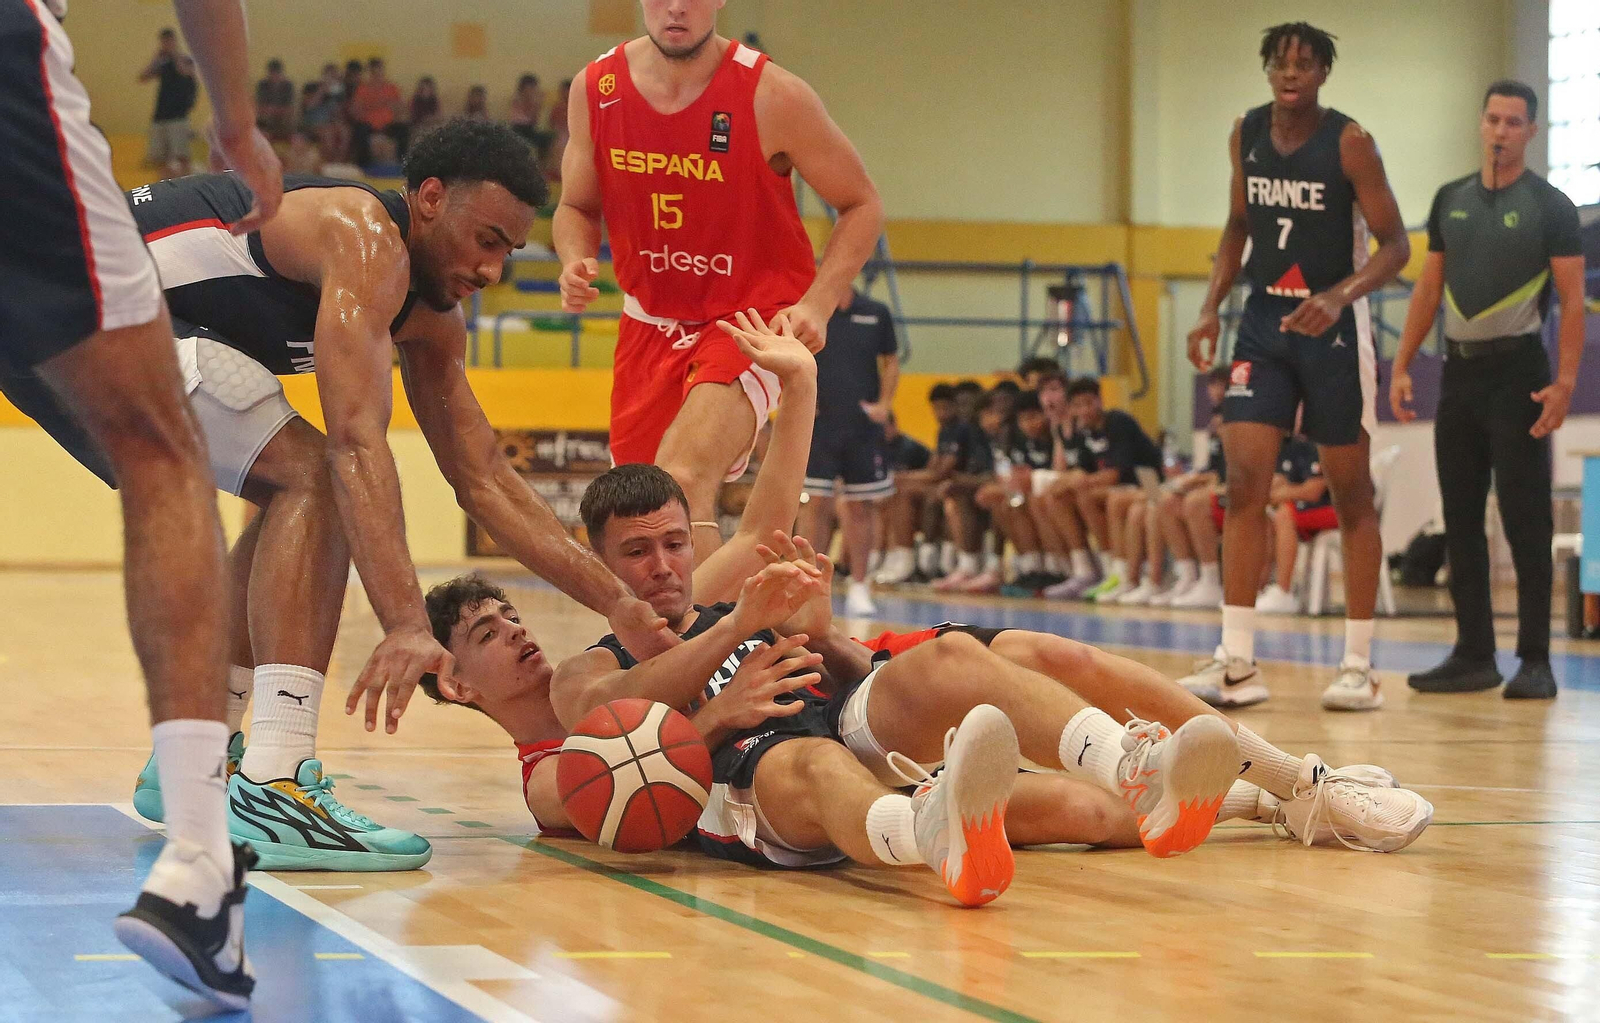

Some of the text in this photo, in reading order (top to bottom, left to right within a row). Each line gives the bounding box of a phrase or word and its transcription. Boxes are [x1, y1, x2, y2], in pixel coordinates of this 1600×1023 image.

[610, 148, 724, 182] ESPAÑA
[1247, 176, 1326, 211] FRANCE
[651, 193, 683, 230] 15
[1276, 217, 1293, 250] 7
